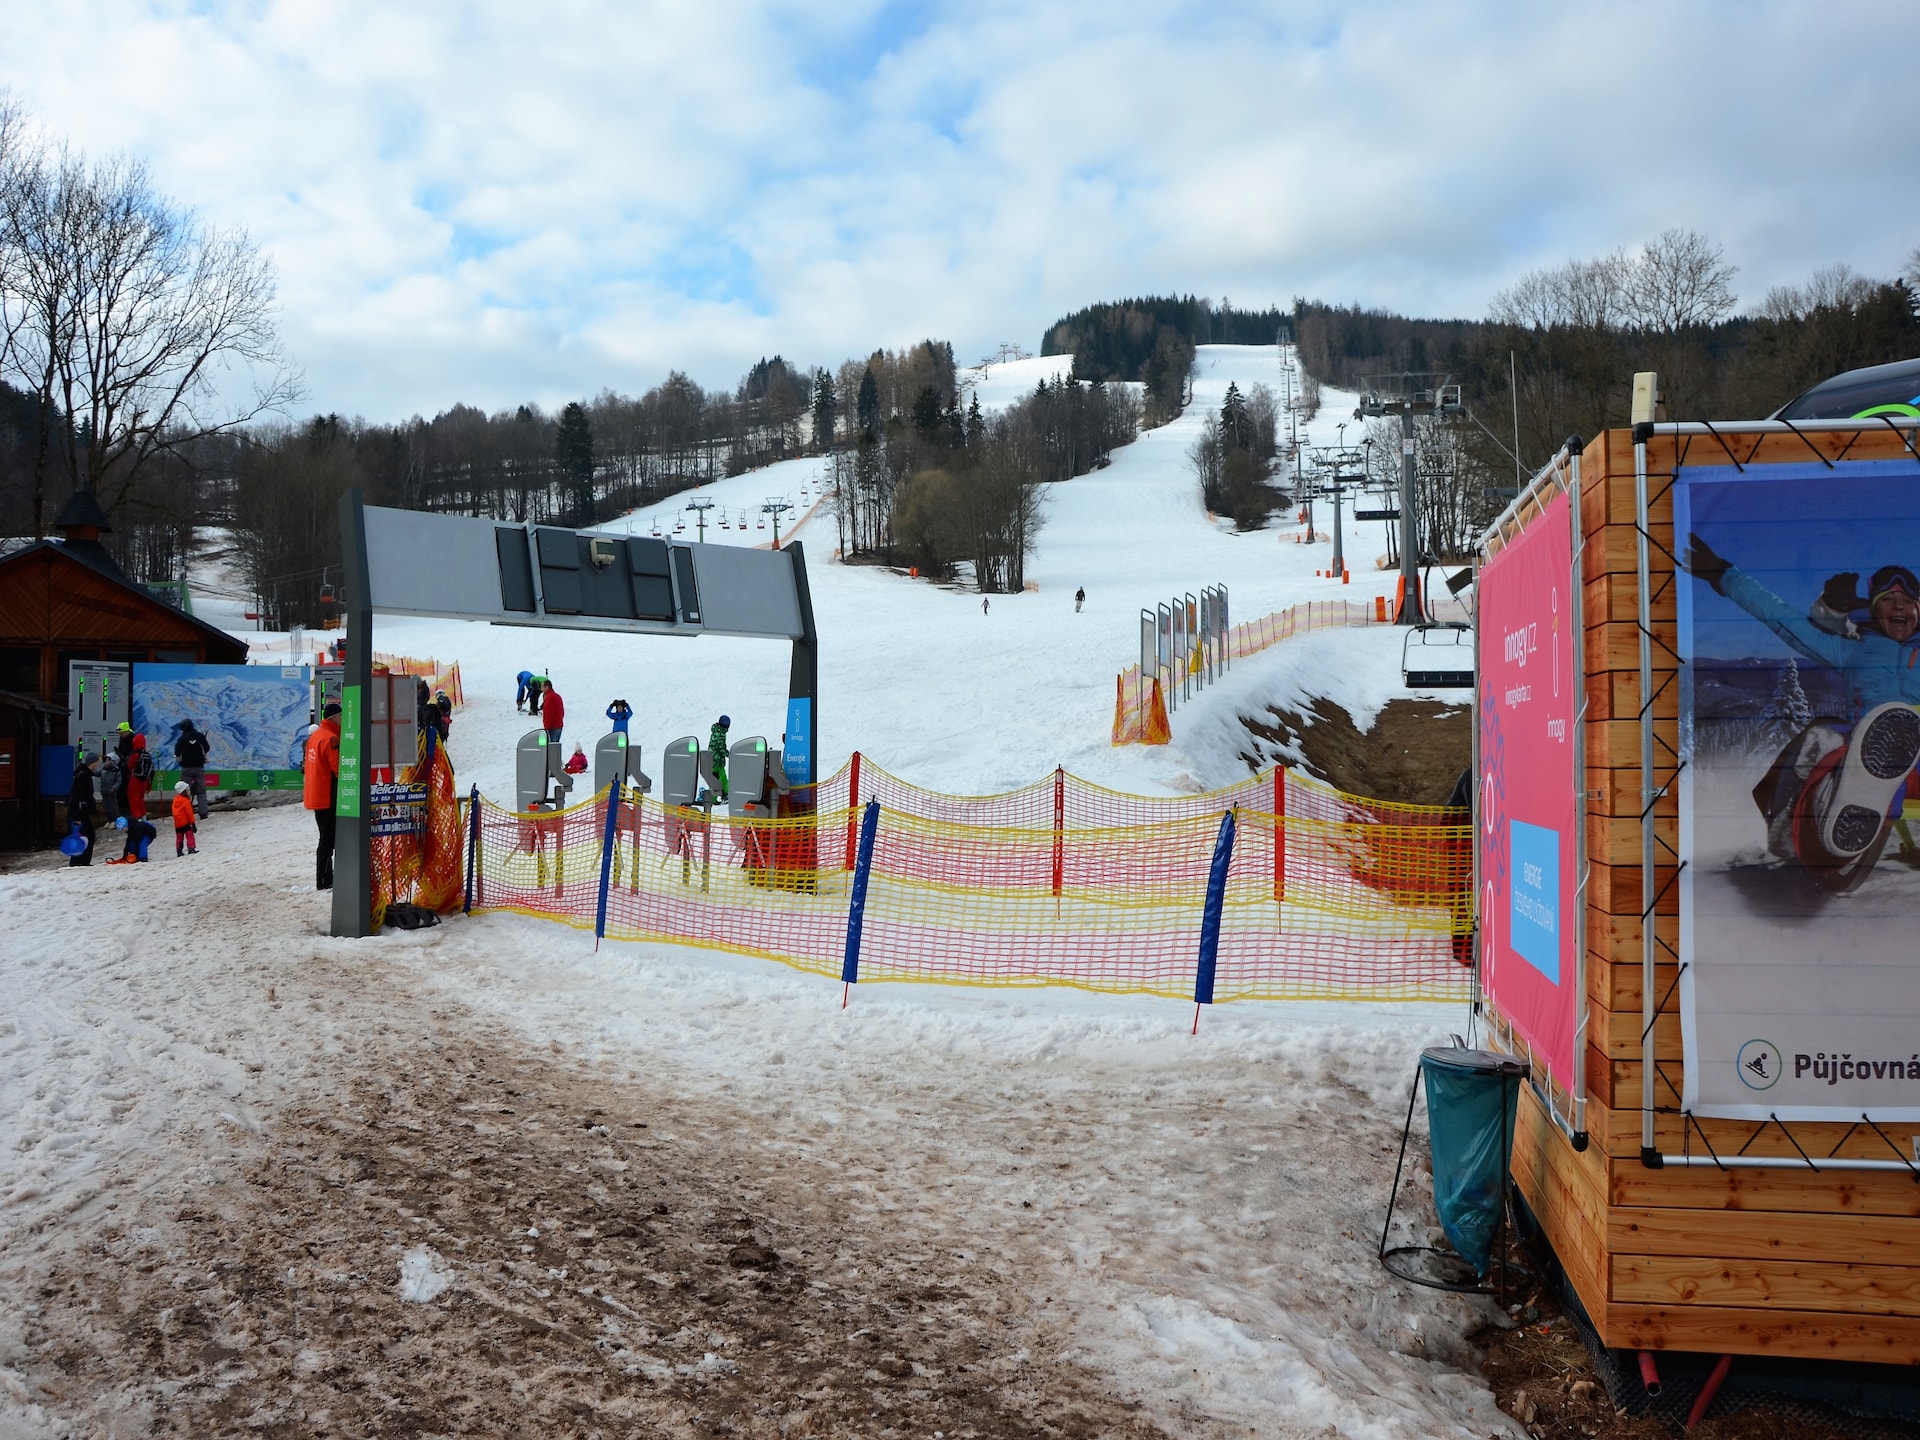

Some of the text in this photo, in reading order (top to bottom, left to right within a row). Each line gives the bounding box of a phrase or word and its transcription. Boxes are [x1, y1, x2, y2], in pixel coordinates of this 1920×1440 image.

[1504, 622, 1537, 668] innogy.cz
[1547, 713, 1566, 743] innogy
[341, 755, 357, 768] Energie
[786, 753, 806, 764] Energie
[1524, 861, 1542, 890] ENERGIE
